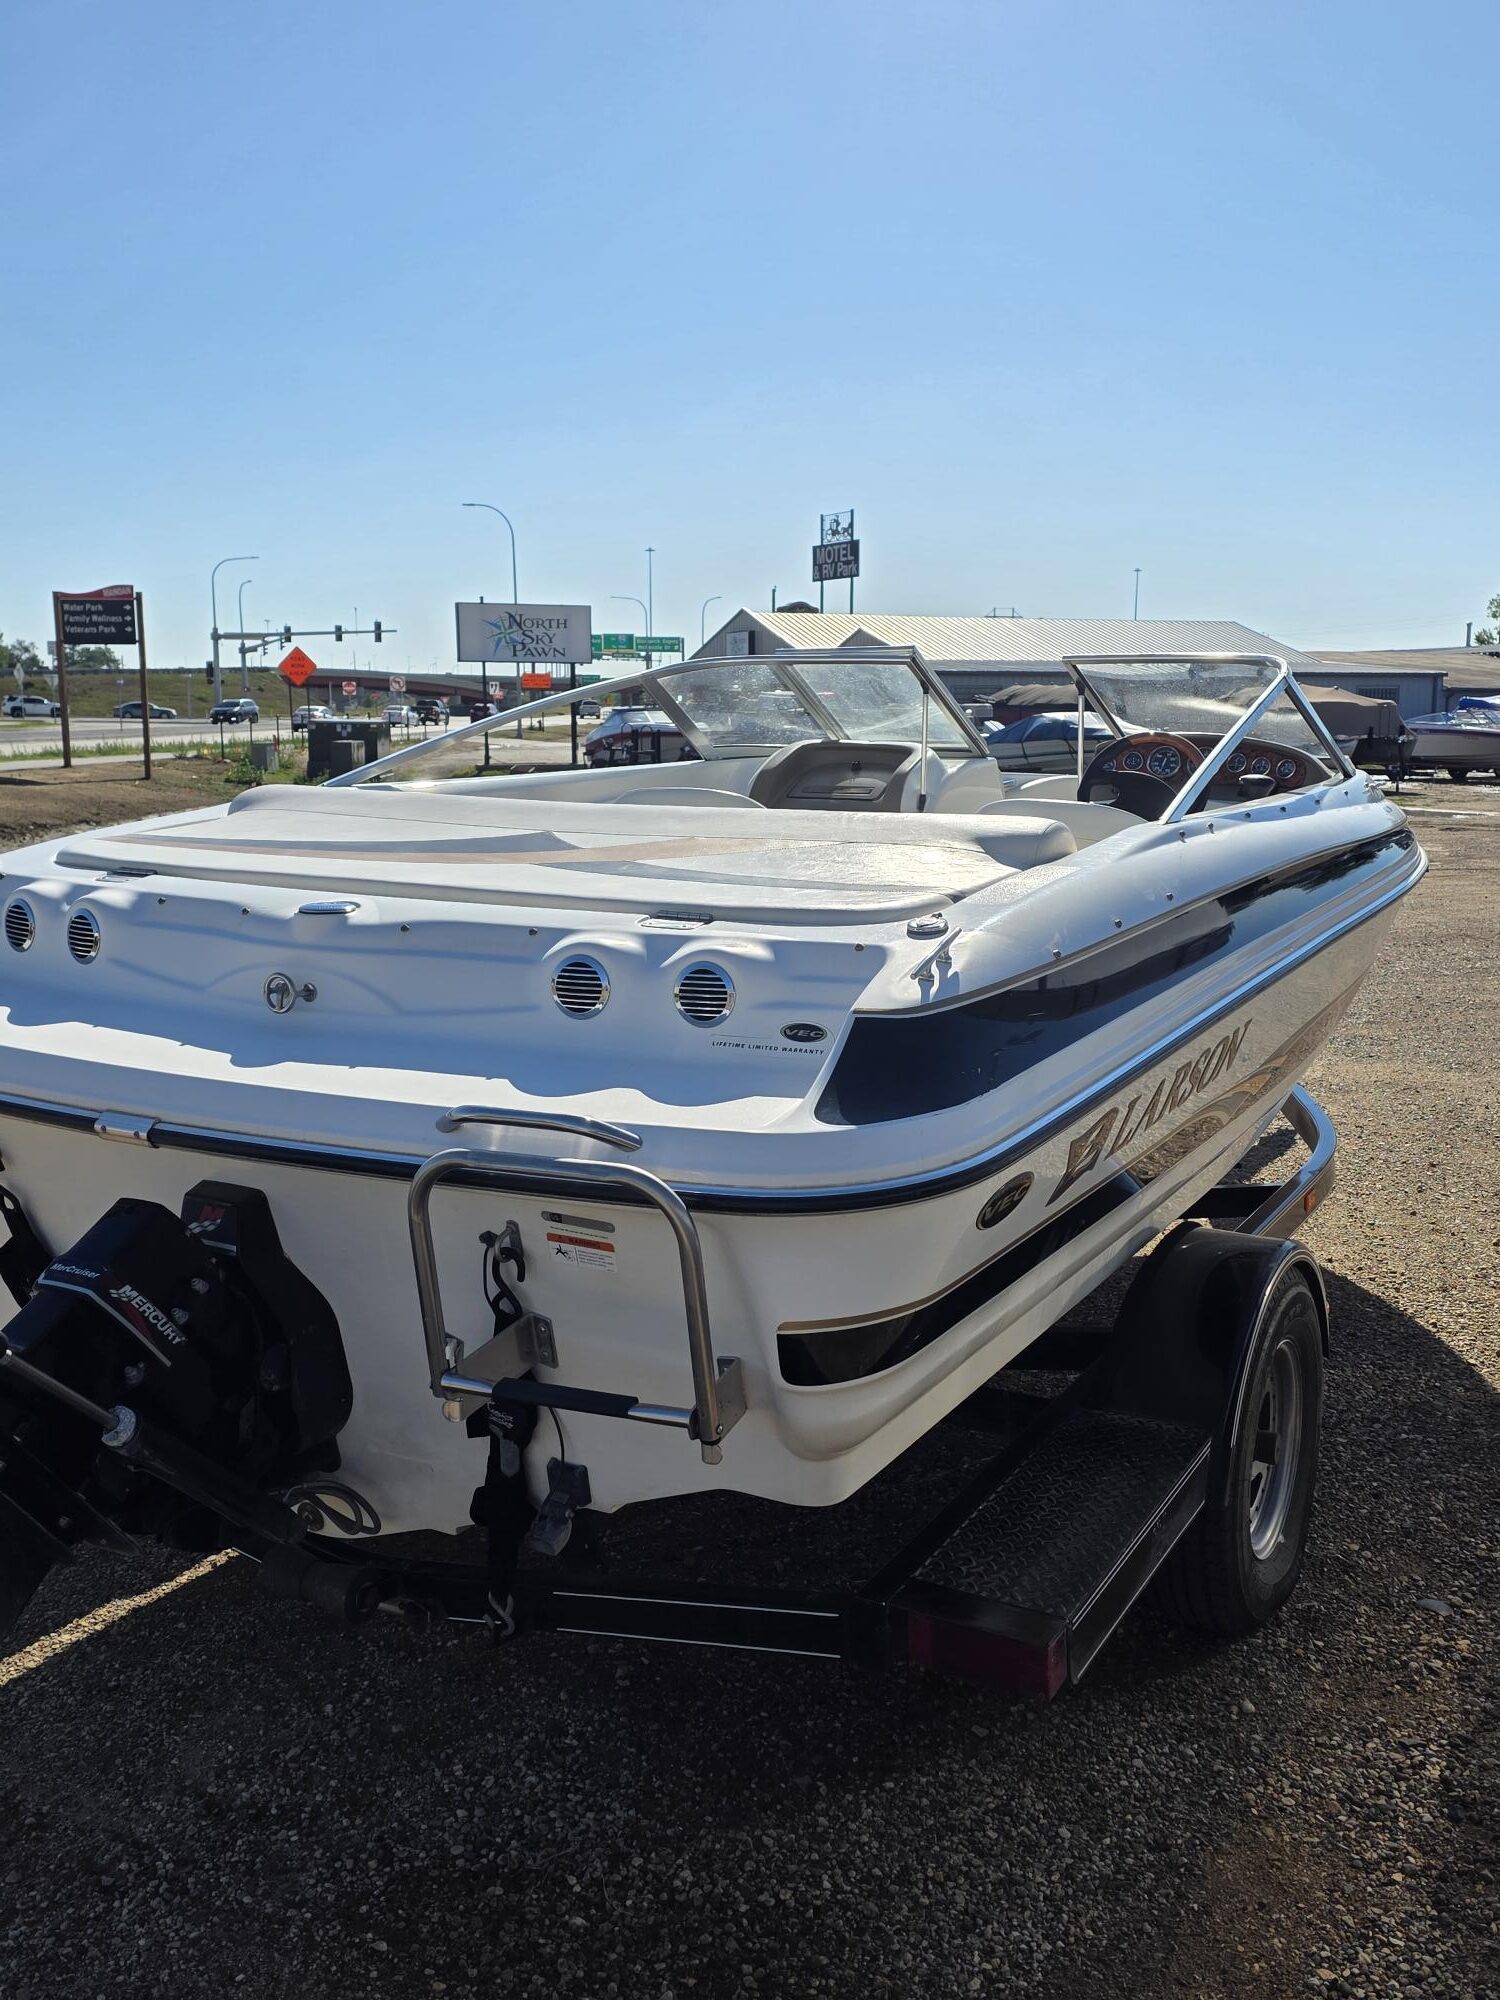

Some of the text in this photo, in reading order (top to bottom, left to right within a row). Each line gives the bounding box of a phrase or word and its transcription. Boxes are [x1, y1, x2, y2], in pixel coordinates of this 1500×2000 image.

[816, 543, 855, 564] MOTEL
[813, 560, 858, 580] & RV Park
[62, 603, 103, 612] Water Park
[64, 614, 123, 623] Family Wellness
[504, 611, 568, 630] NORTH
[65, 625, 116, 633] Veterans Park
[521, 629, 556, 645] SKY
[511, 646, 567, 658] PAWN
[785, 1027, 823, 1038] VEC
[711, 1040, 825, 1056] LIFETIME LIMITED WARRANTY
[1103, 1018, 1252, 1161] LARSON
[50, 1262, 101, 1279] MerCruiser
[118, 1284, 189, 1345] MERCURY
